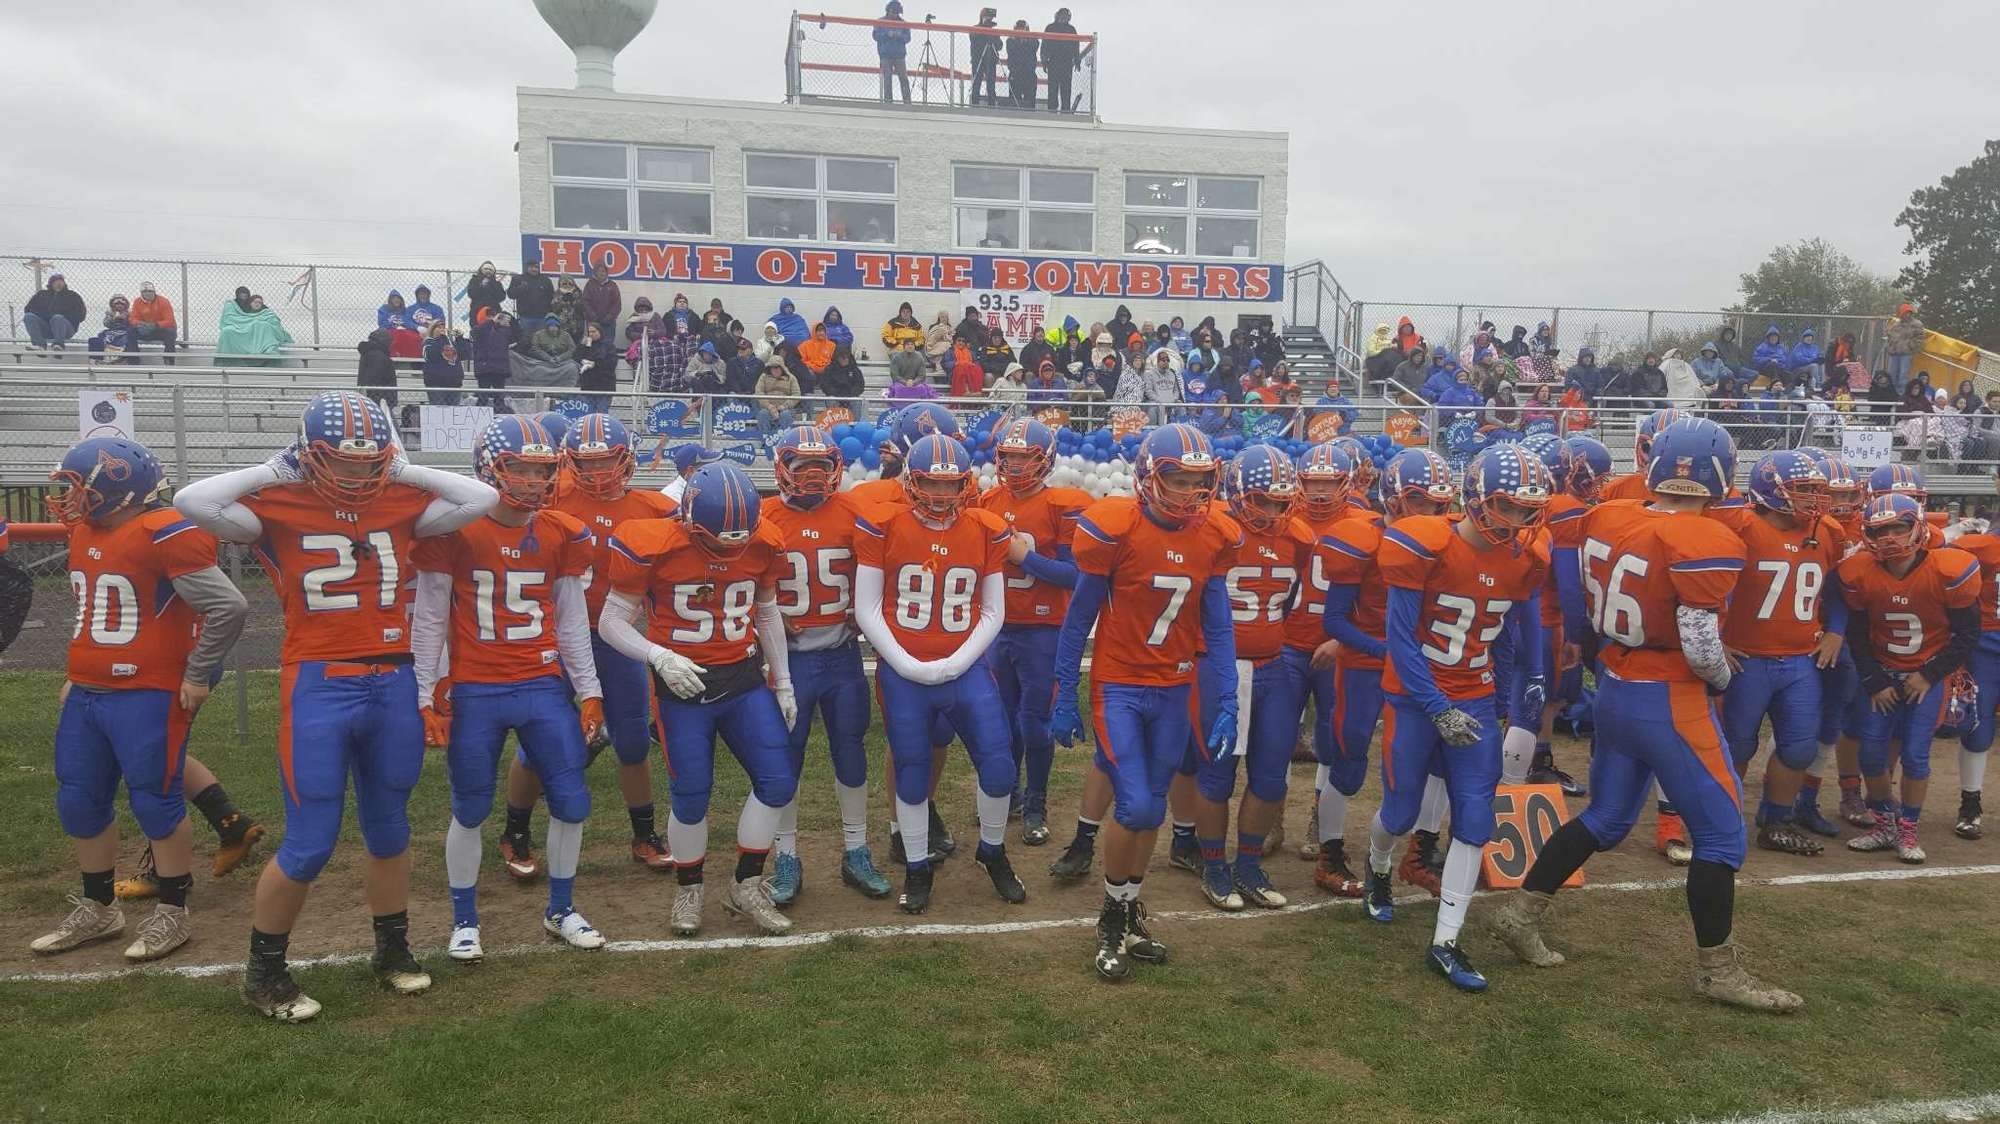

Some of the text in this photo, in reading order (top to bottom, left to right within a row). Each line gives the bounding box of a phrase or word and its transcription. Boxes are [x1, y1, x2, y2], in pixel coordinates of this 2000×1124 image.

[539, 238, 1271, 298] HOME OF THE BOMBERS
[979, 293, 1045, 313] 93.5 THE
[987, 312, 1045, 338] AME
[437, 406, 493, 425] TEAM
[554, 399, 589, 416] erson
[722, 420, 746, 432] #33
[435, 427, 484, 449] DREA
[1860, 433, 1873, 441] GO
[1843, 446, 1889, 459] BOMBERS
[596, 515, 612, 527] RO
[1004, 511, 1016, 521] RO
[802, 529, 819, 539] RO
[88, 547, 102, 560] RO
[501, 546, 521, 559] RO
[931, 543, 948, 556] RO
[1167, 550, 1184, 563] RO
[1783, 543, 1799, 553] RO
[302, 531, 399, 610] 21
[1479, 573, 1495, 587] RO
[777, 548, 851, 616] 35
[1757, 561, 1823, 621] 78
[896, 564, 978, 633] 88
[1226, 566, 1297, 622] 52
[1583, 537, 1648, 648] 56
[1892, 595, 1909, 605] RO
[472, 569, 546, 641] 15
[672, 580, 756, 643] 58
[1146, 575, 1192, 645] 7
[1885, 612, 1924, 655] 3
[1488, 792, 1563, 880] 50
